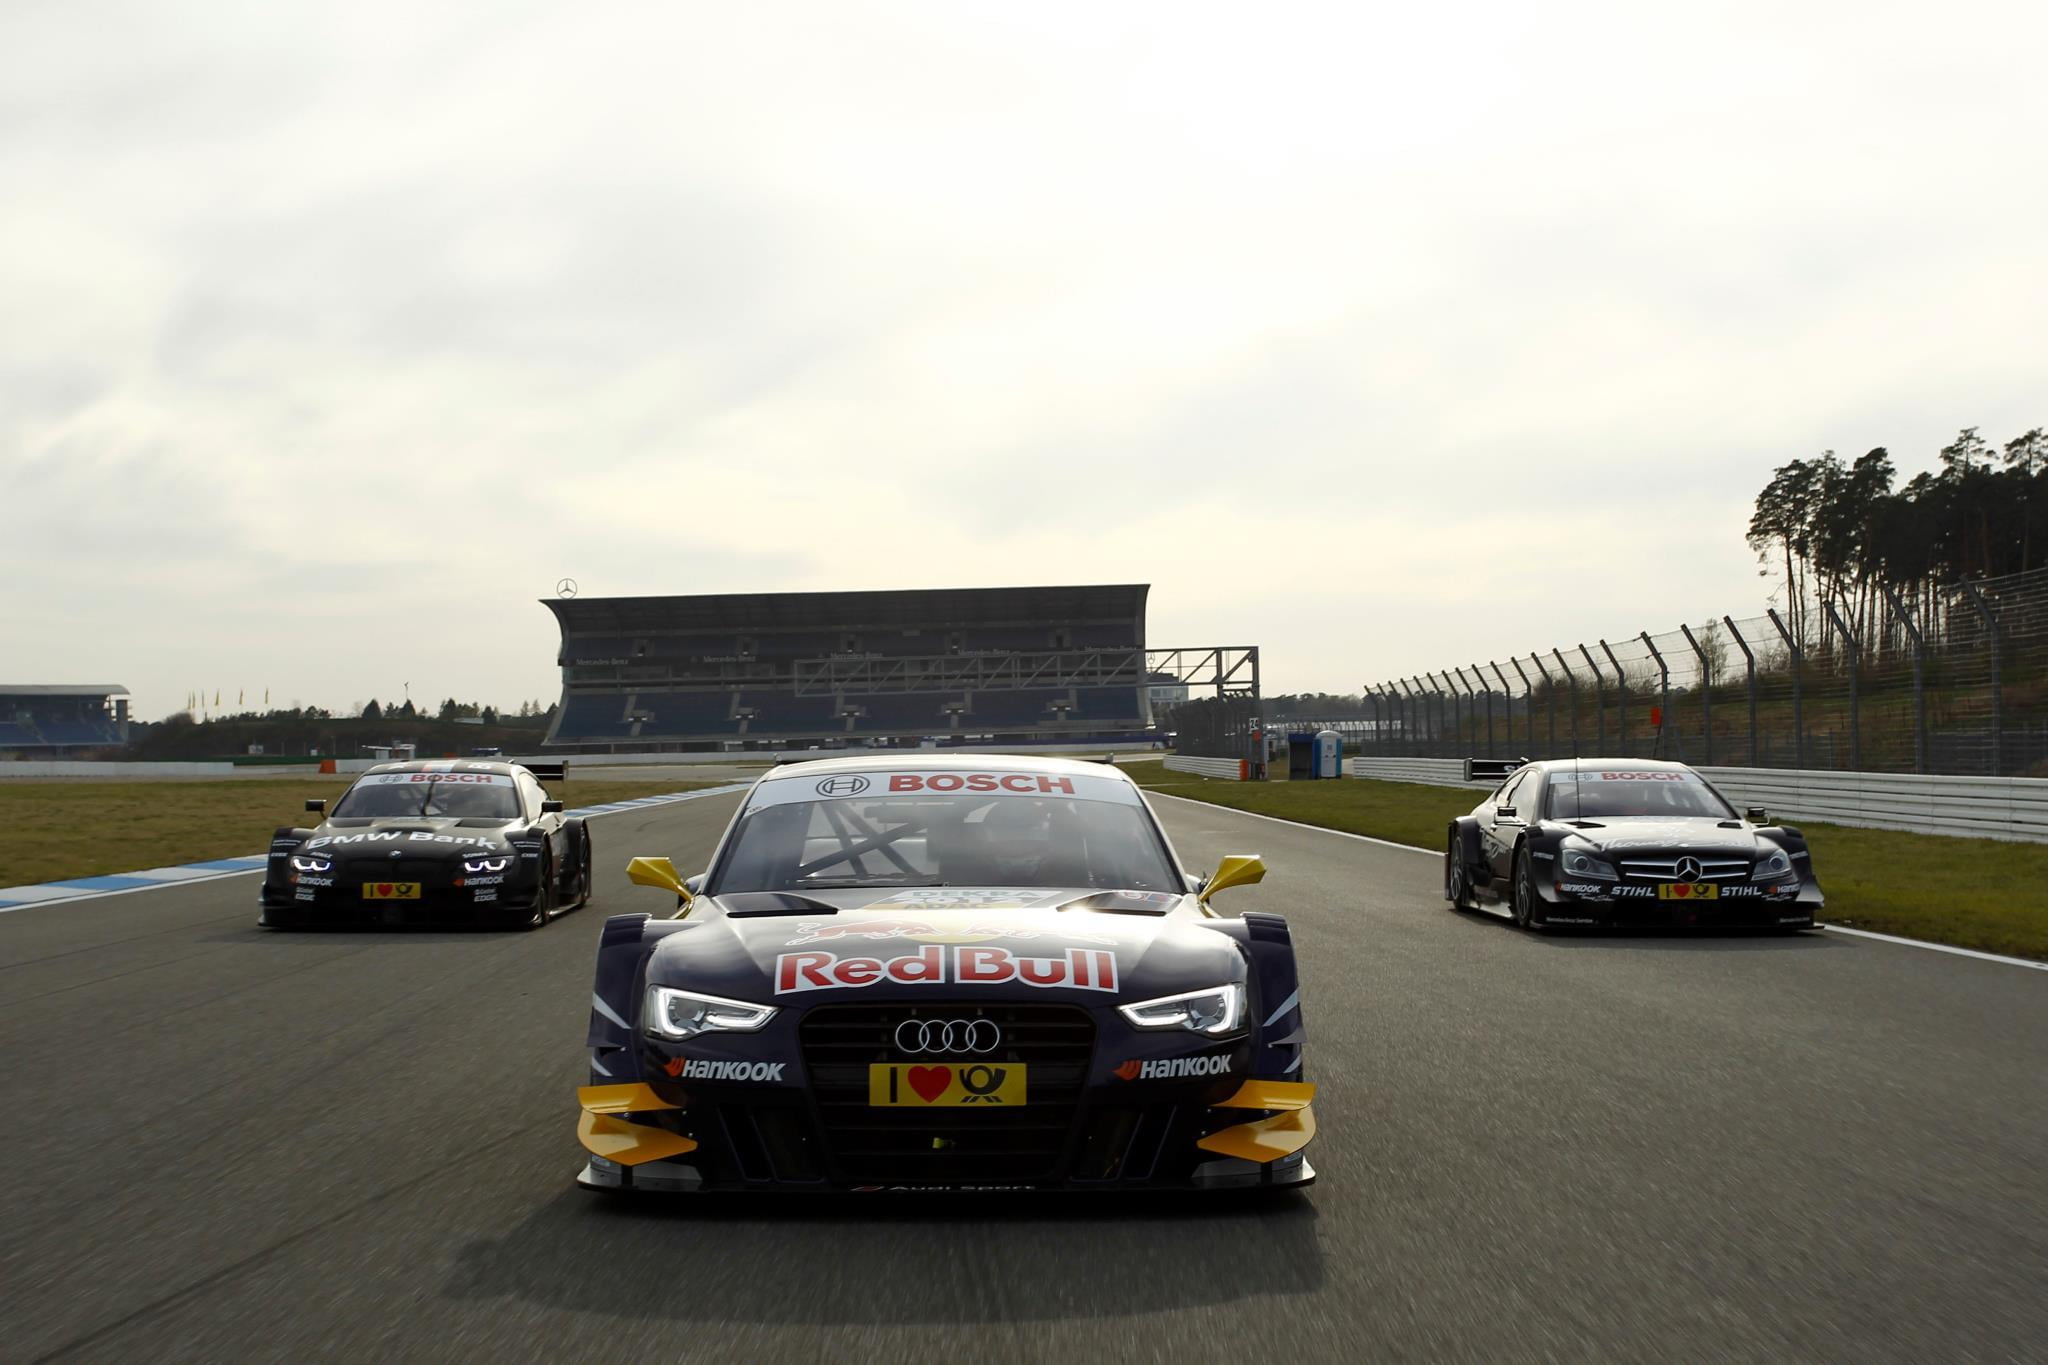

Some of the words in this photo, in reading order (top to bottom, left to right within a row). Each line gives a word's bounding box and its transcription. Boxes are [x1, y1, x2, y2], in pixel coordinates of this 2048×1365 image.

[410, 774, 492, 783] BOSCH
[1602, 771, 1685, 782] BOSCH
[889, 773, 1075, 795] BOSCH
[306, 831, 402, 850] BMW
[408, 831, 497, 851] Bank
[1611, 886, 1656, 896] STIHL
[1721, 886, 1762, 896] STIHL
[775, 945, 945, 995] Red
[955, 946, 1118, 993] Bull
